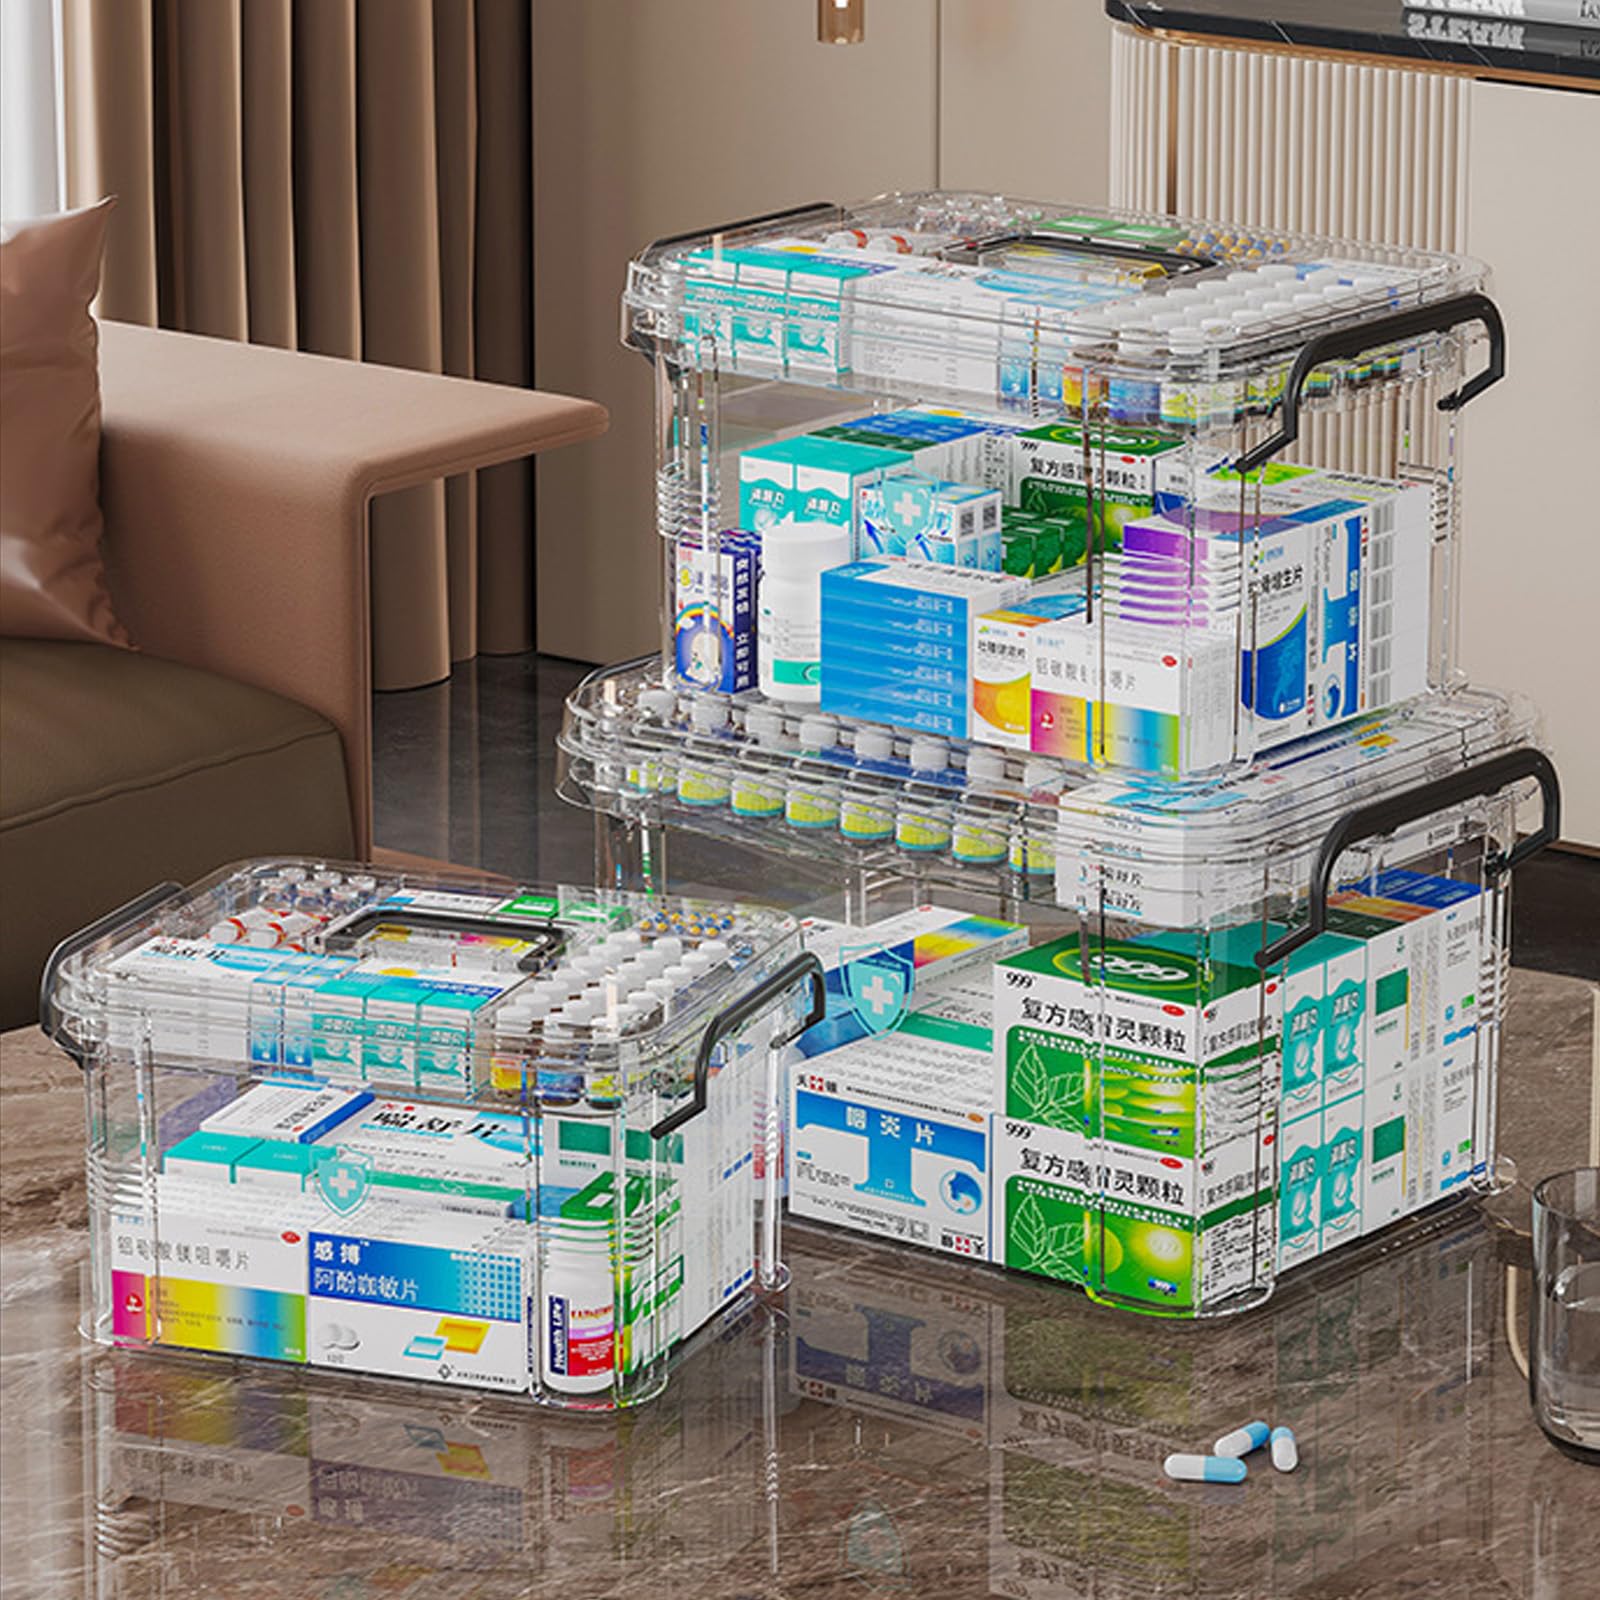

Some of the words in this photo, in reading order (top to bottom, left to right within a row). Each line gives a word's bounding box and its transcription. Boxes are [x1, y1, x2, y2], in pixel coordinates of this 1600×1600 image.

[1030, 457, 1137, 490] 复方感颗粒
[1005, 971, 1034, 989] 999
[1020, 997, 1187, 1054] 复方感冒灵颗粒
[1005, 1122, 1033, 1140] 999
[1019, 1147, 1185, 1206] 复方感冒灵颗粒
